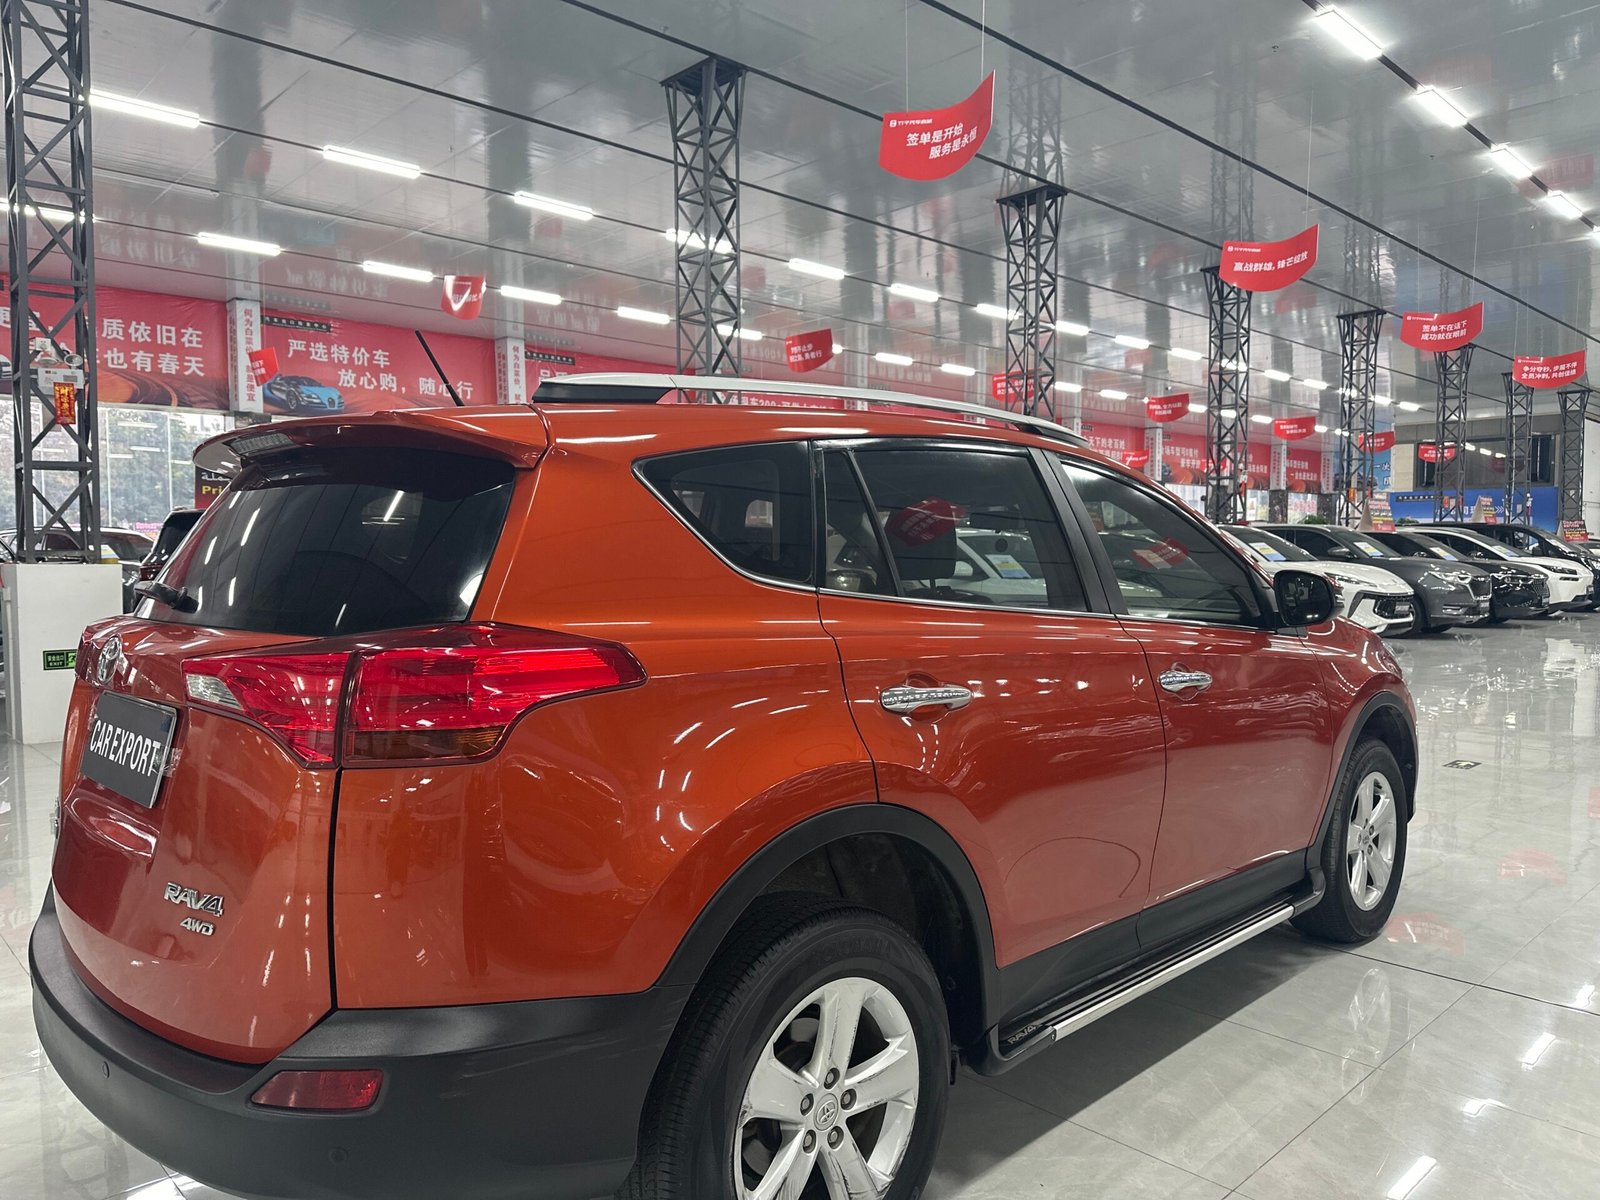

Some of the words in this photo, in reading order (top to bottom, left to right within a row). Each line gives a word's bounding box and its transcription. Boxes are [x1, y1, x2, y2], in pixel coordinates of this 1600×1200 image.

[906, 122, 963, 146] 签单是开始
[929, 125, 978, 159] 服务是永恒
[288, 338, 391, 368] 严选特价车
[337, 368, 474, 400] 放心购，随心行
[90, 719, 114, 758] CAR
[108, 727, 161, 777] EXPORT
[164, 882, 224, 917] RAV4
[180, 917, 214, 936] 4WD
[1008, 1024, 1037, 1044] RAV4
